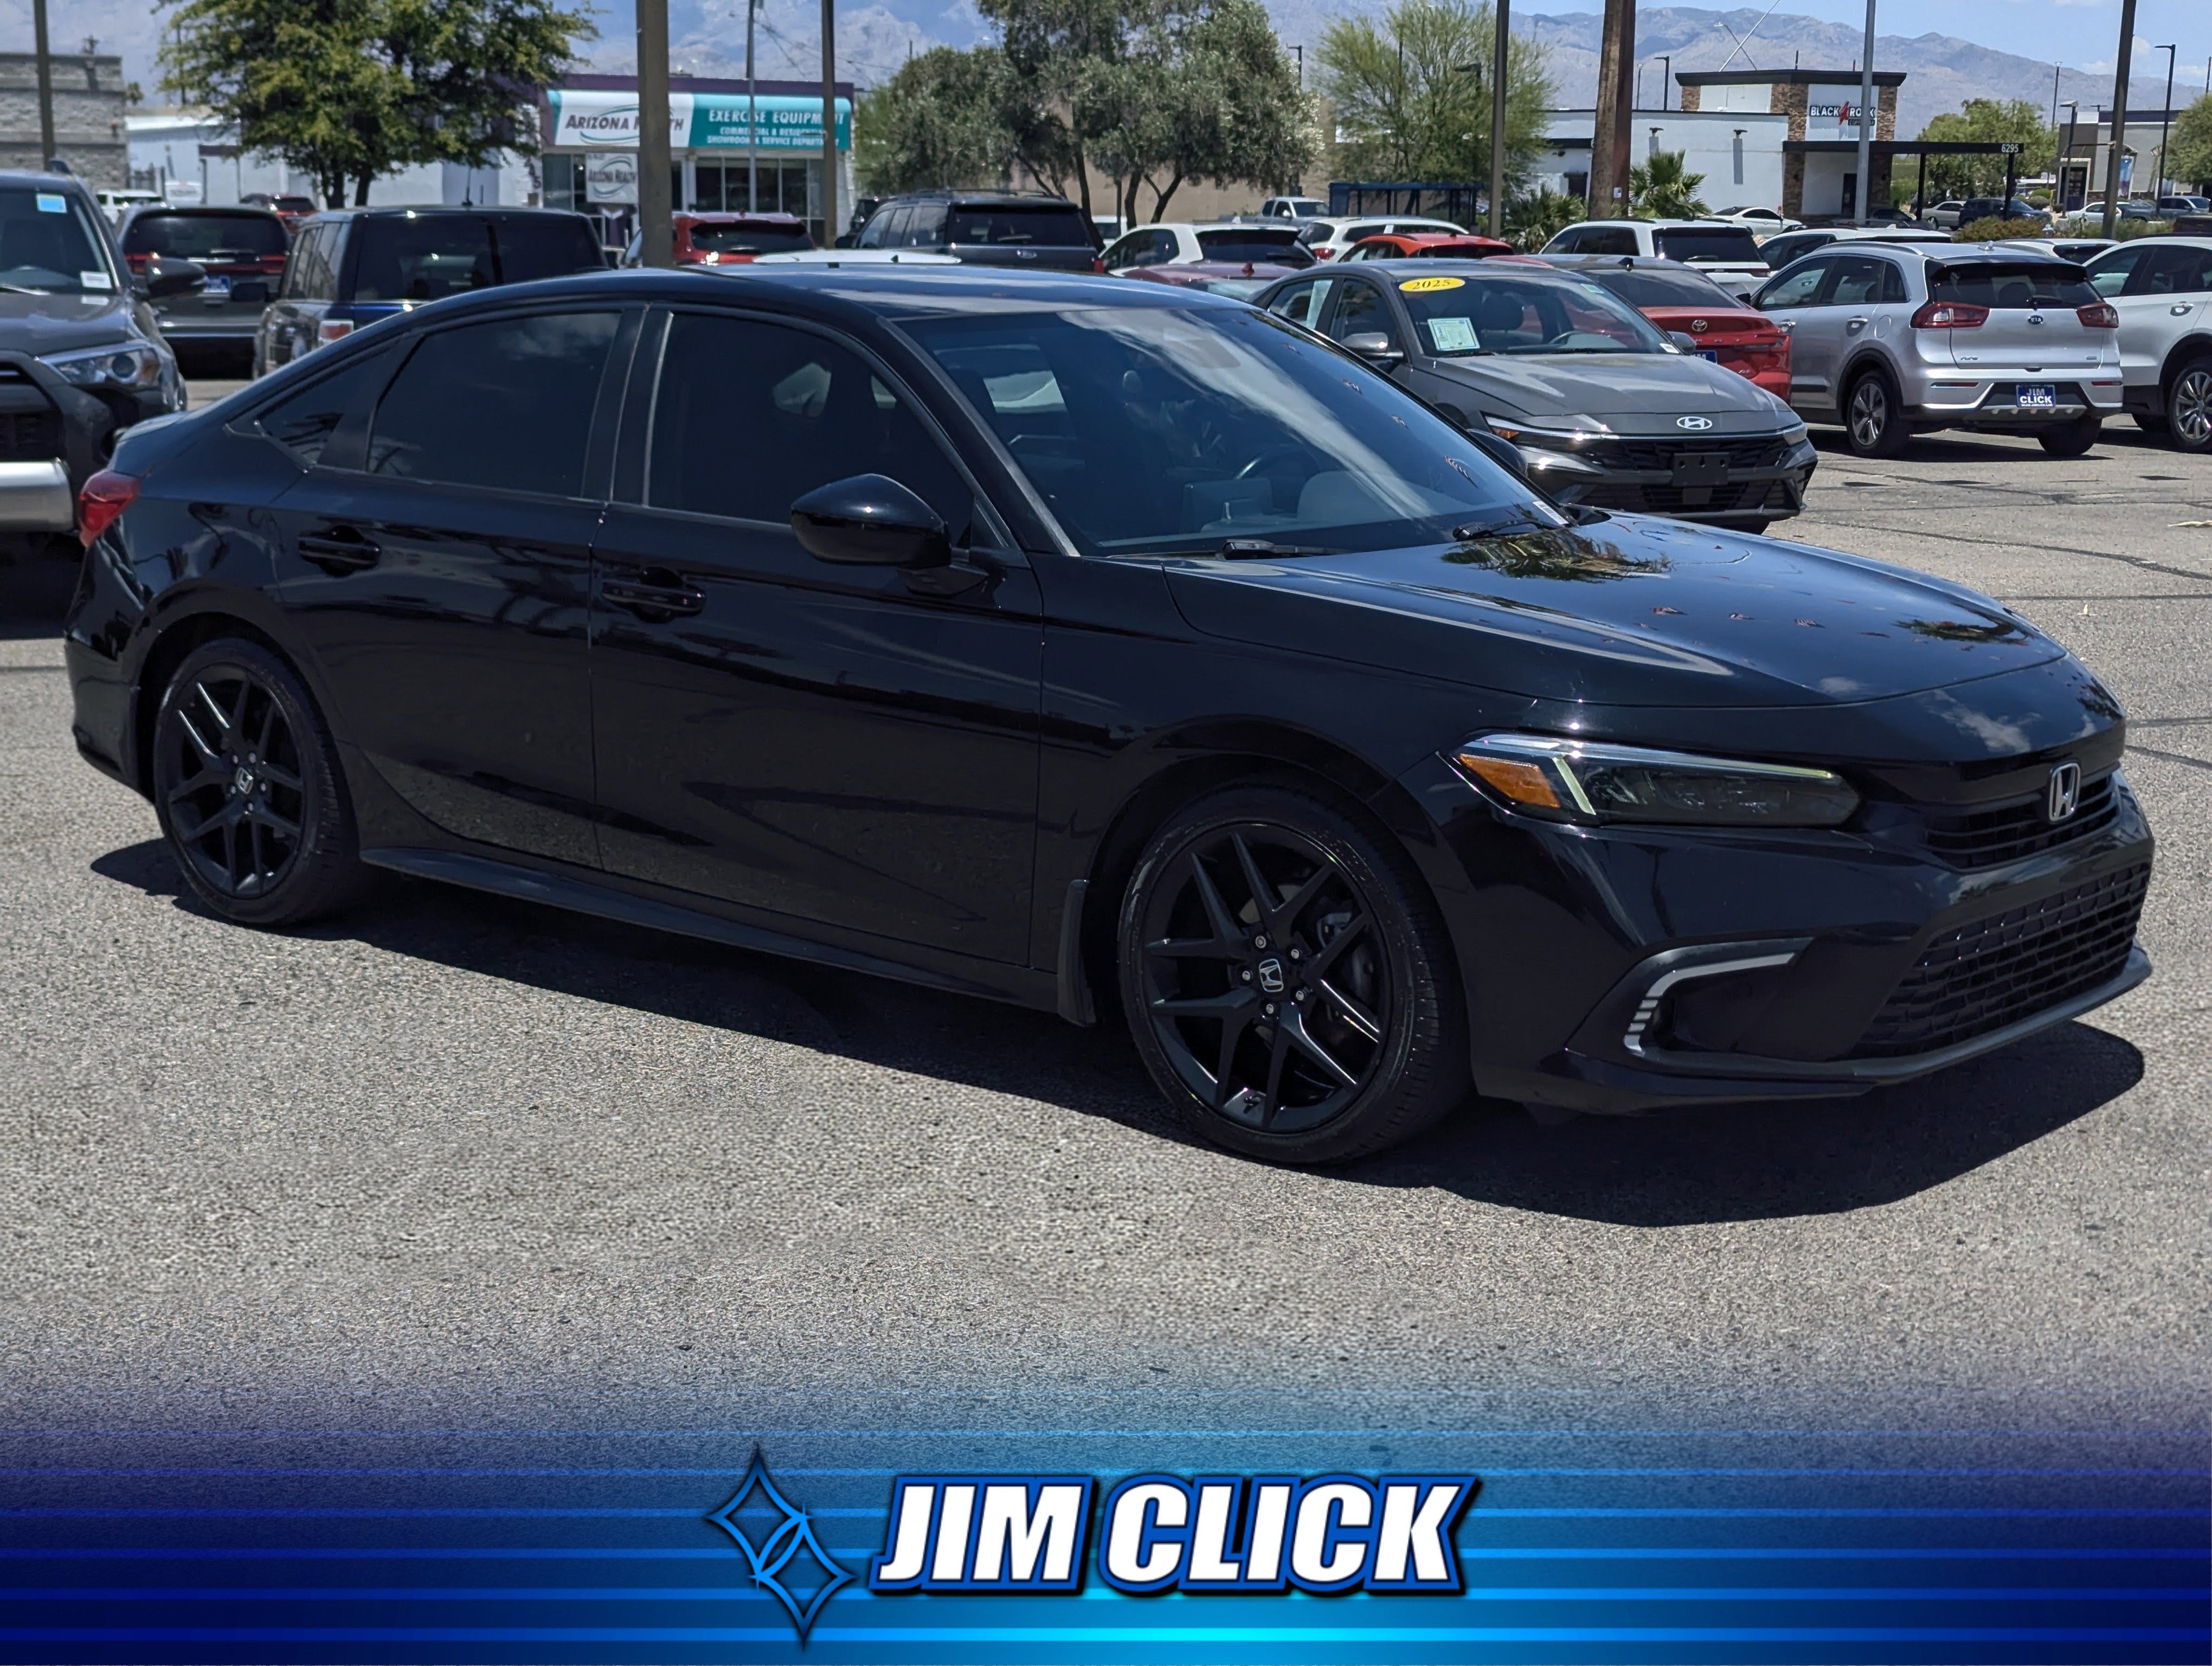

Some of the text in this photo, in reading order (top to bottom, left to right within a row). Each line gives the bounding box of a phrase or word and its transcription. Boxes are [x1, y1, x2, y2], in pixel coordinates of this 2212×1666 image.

[1811, 106, 1874, 117] BLACK ROK
[565, 114, 629, 130] ARIZONA
[773, 111, 845, 125] EQUIPMT
[2002, 143, 2019, 152] 6295
[1411, 279, 1451, 290] 2025
